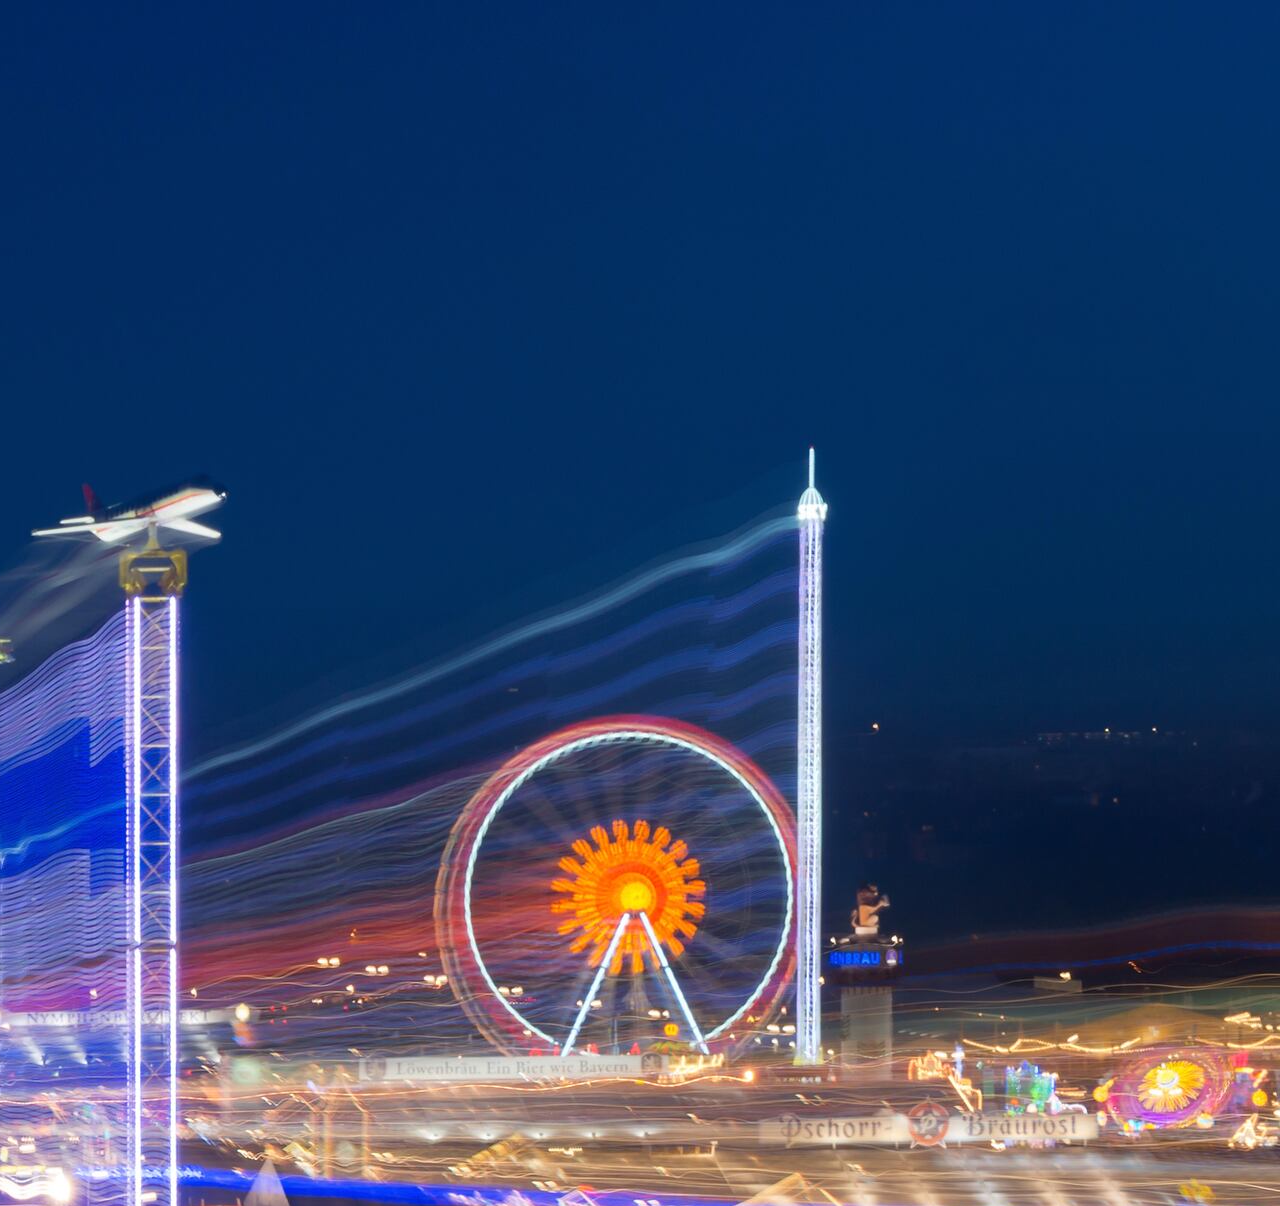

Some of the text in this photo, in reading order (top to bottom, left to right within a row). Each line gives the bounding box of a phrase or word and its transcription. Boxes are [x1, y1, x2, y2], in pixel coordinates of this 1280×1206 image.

[487, 1061, 510, 1075] Ein
[517, 1061, 544, 1074] Bier
[550, 1061, 574, 1074] wie
